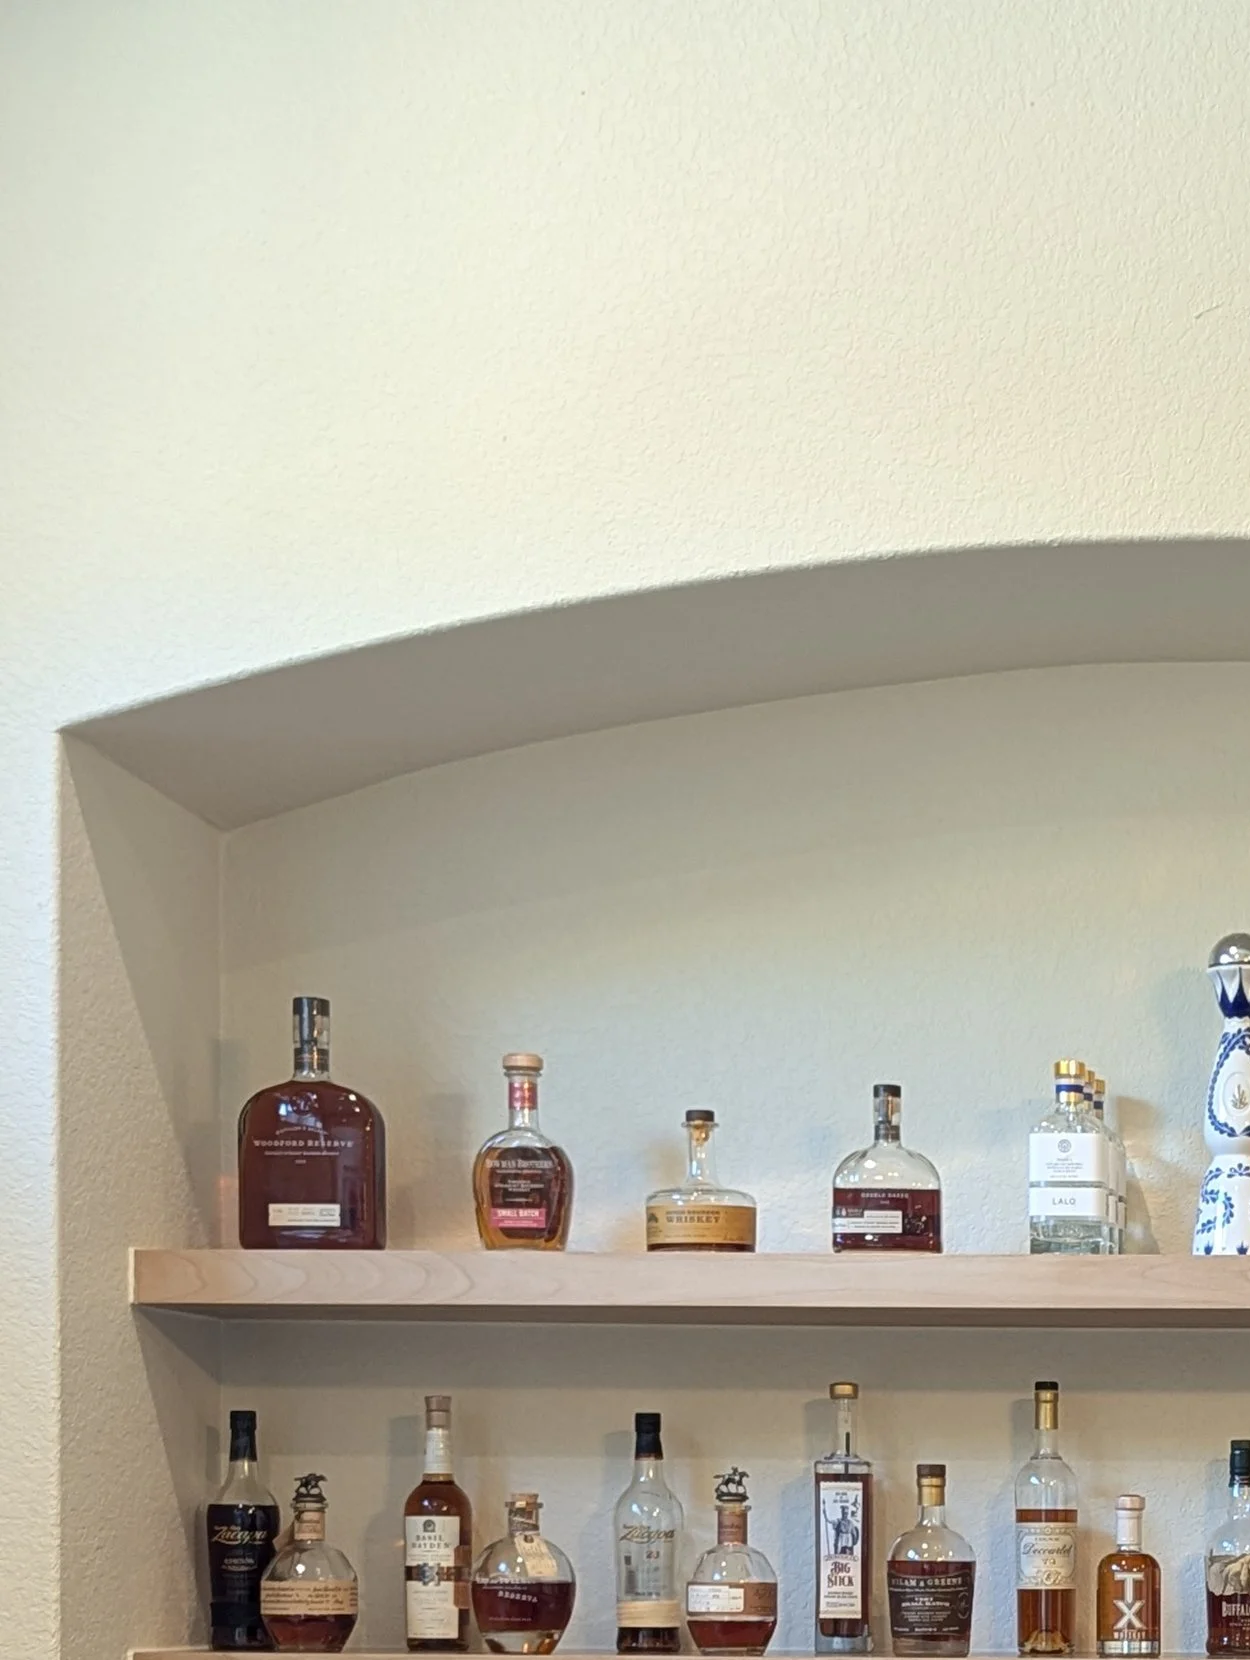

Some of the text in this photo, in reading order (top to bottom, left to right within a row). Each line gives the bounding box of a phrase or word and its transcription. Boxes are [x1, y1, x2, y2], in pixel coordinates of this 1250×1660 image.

[253, 1139, 354, 1148] WOODFORD RESERVE
[1052, 1197, 1077, 1206] LALO
[496, 1208, 540, 1217] SMALL BATCH
[666, 1215, 721, 1224] WHISKEY
[416, 1534, 443, 1542] BASIL
[831, 1561, 852, 1575] BIG
[827, 1574, 855, 1588] STICK
